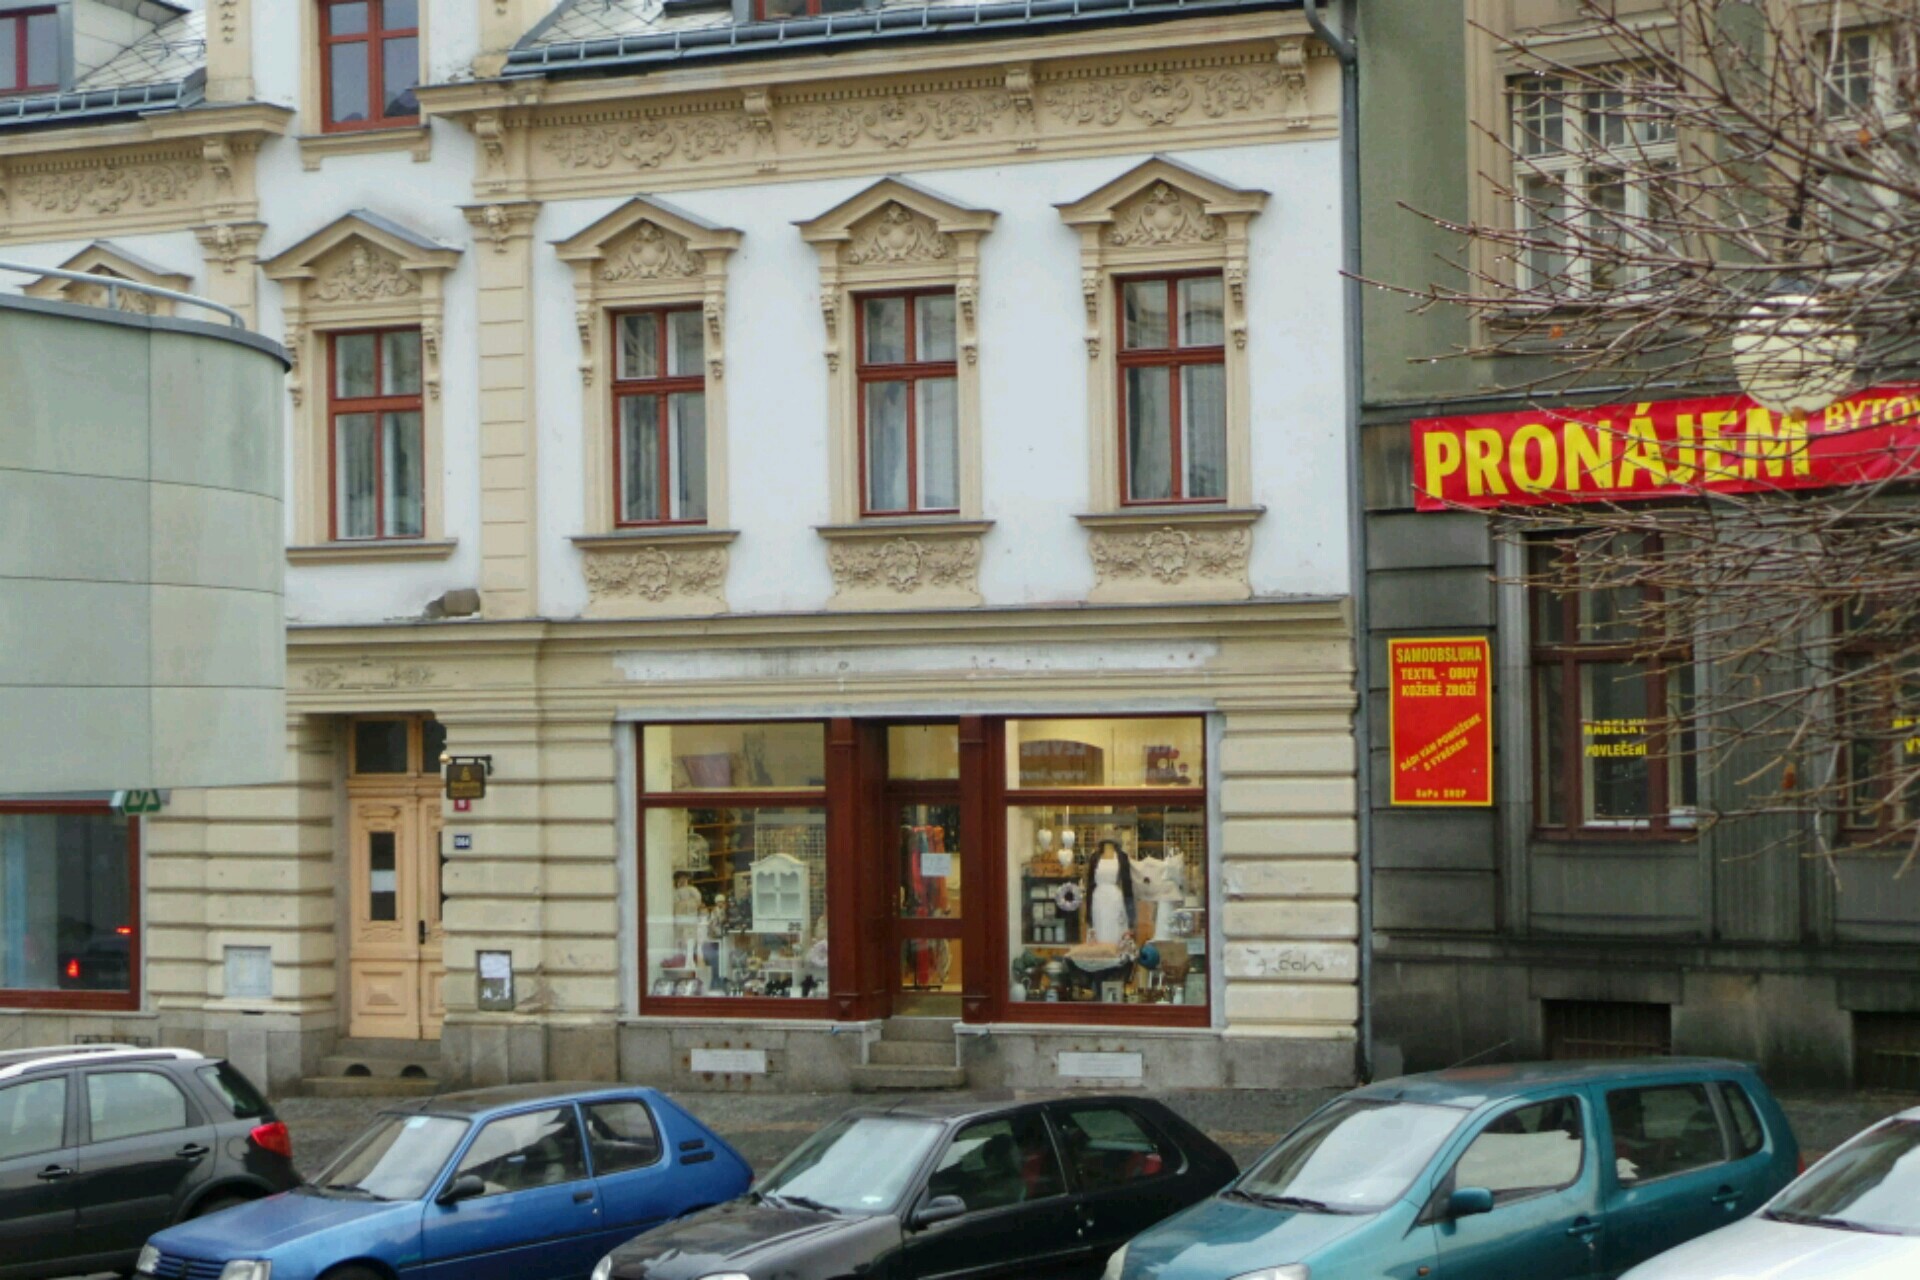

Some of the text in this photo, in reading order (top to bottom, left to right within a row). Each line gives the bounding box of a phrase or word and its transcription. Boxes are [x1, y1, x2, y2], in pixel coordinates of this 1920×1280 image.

[1424, 402, 1810, 496] PRONÁJEM
[1396, 646, 1482, 663] SAMOOBSLUHA
[1401, 667, 1437, 680] TEXTIL
[1449, 667, 1479, 680] OBUV
[1402, 681, 1477, 697] KOŽENÉ ZBOŽÍ
